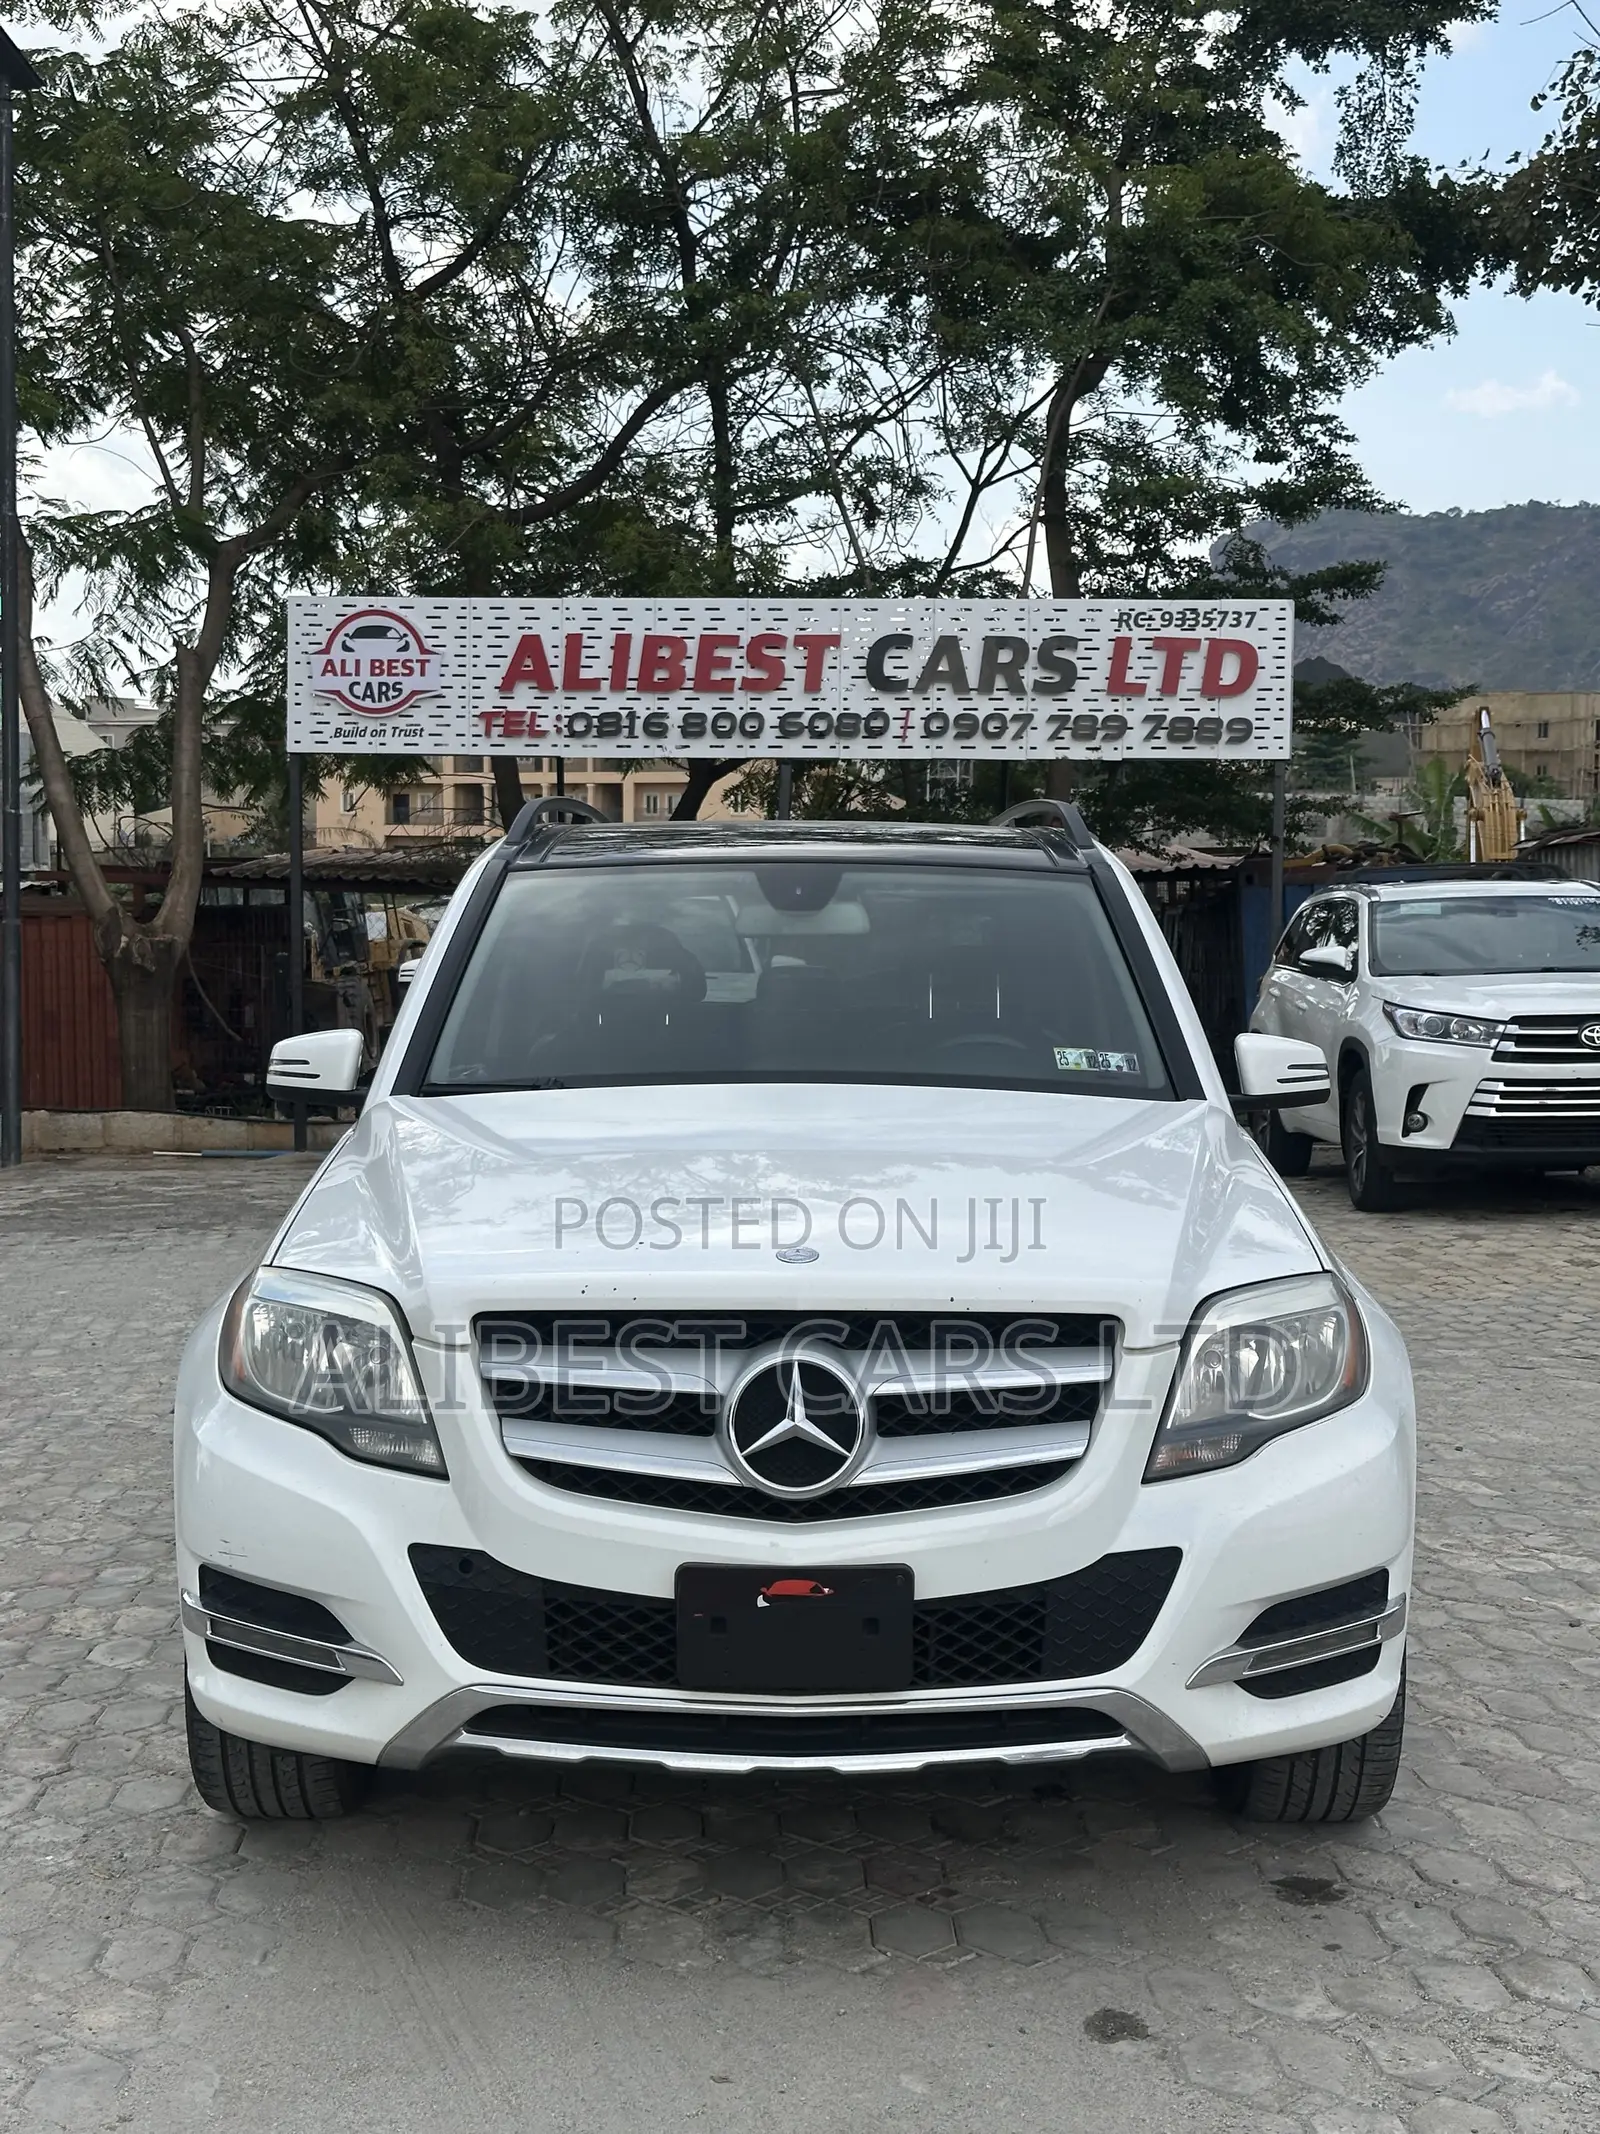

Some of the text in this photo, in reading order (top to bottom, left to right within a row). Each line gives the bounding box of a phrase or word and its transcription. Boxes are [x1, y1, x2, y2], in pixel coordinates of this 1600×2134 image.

[1160, 611, 1257, 628] 9335737
[320, 658, 431, 677] ALI BEST
[499, 632, 1260, 699] ALIBEST CARS LTD
[348, 681, 404, 703] CARS
[370, 729, 387, 738] on
[391, 726, 425, 738] Trust
[681, 711, 765, 739] 800
[778, 711, 890, 738] 6080
[923, 711, 1034, 741] 0907
[1046, 713, 1128, 742] 789
[1141, 714, 1254, 744] 7889
